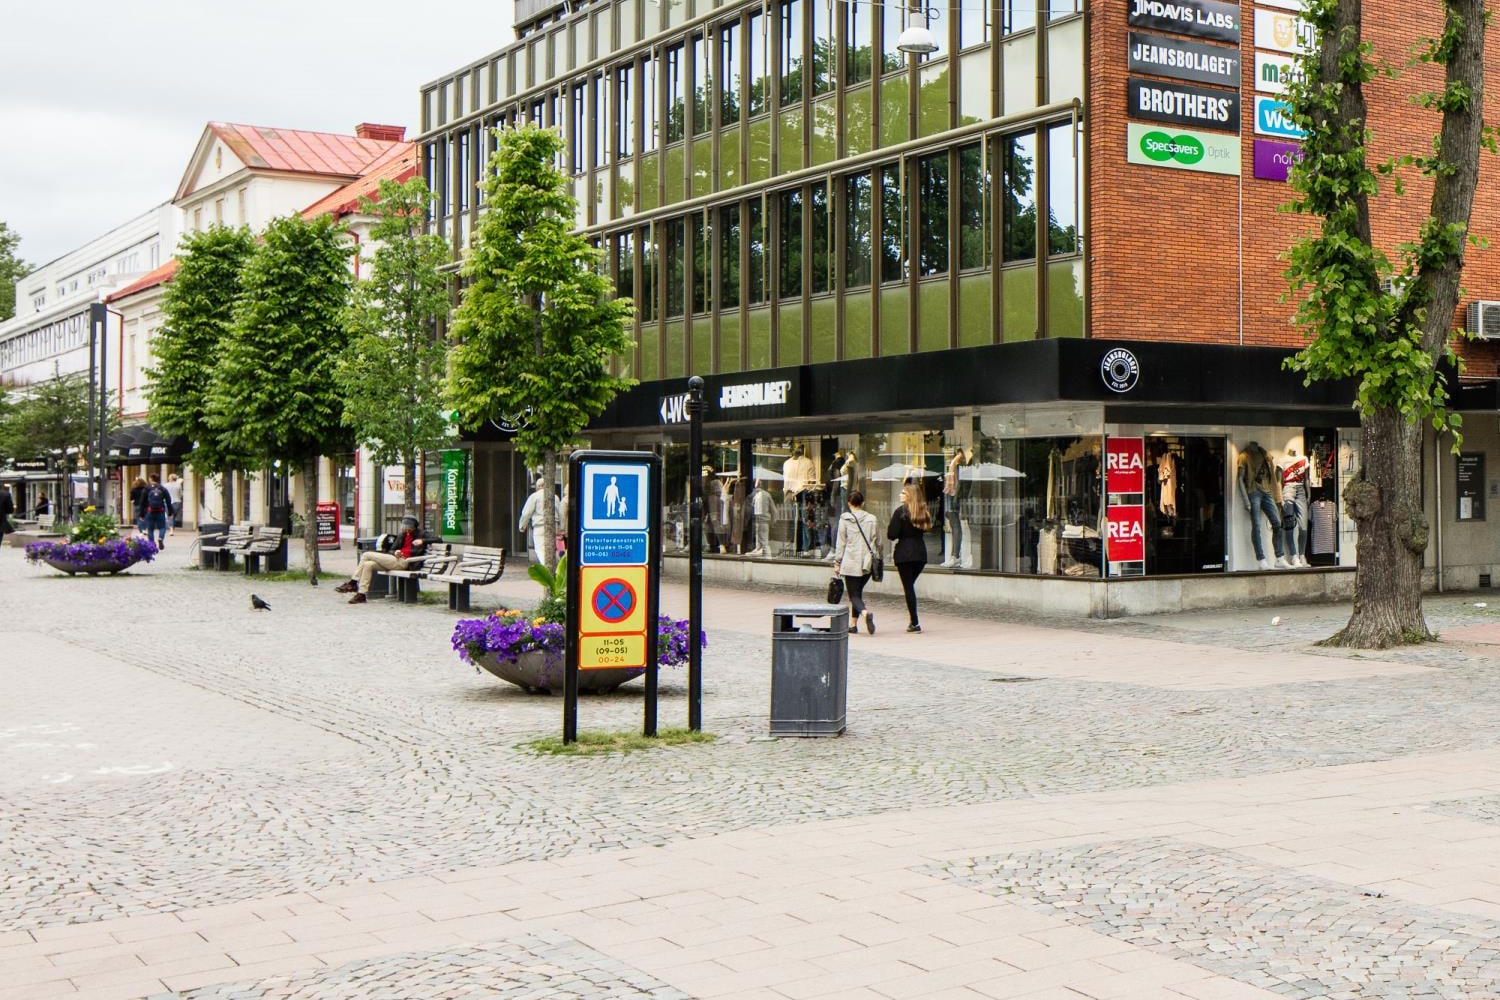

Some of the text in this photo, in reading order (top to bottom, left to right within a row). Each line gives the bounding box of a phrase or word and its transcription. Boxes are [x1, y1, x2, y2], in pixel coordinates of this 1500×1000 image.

[1133, 43, 1233, 76] JEANSBOLAGET
[1139, 86, 1230, 122] BROTHERS
[1146, 138, 1231, 159] Specsavers Optik
[1107, 452, 1143, 470] REA
[446, 468, 459, 531] Kontaktlinser
[1107, 521, 1144, 538] REA
[595, 646, 628, 656] (09-05)
[603, 638, 625, 646] 11-05
[598, 656, 625, 664] 00-24
